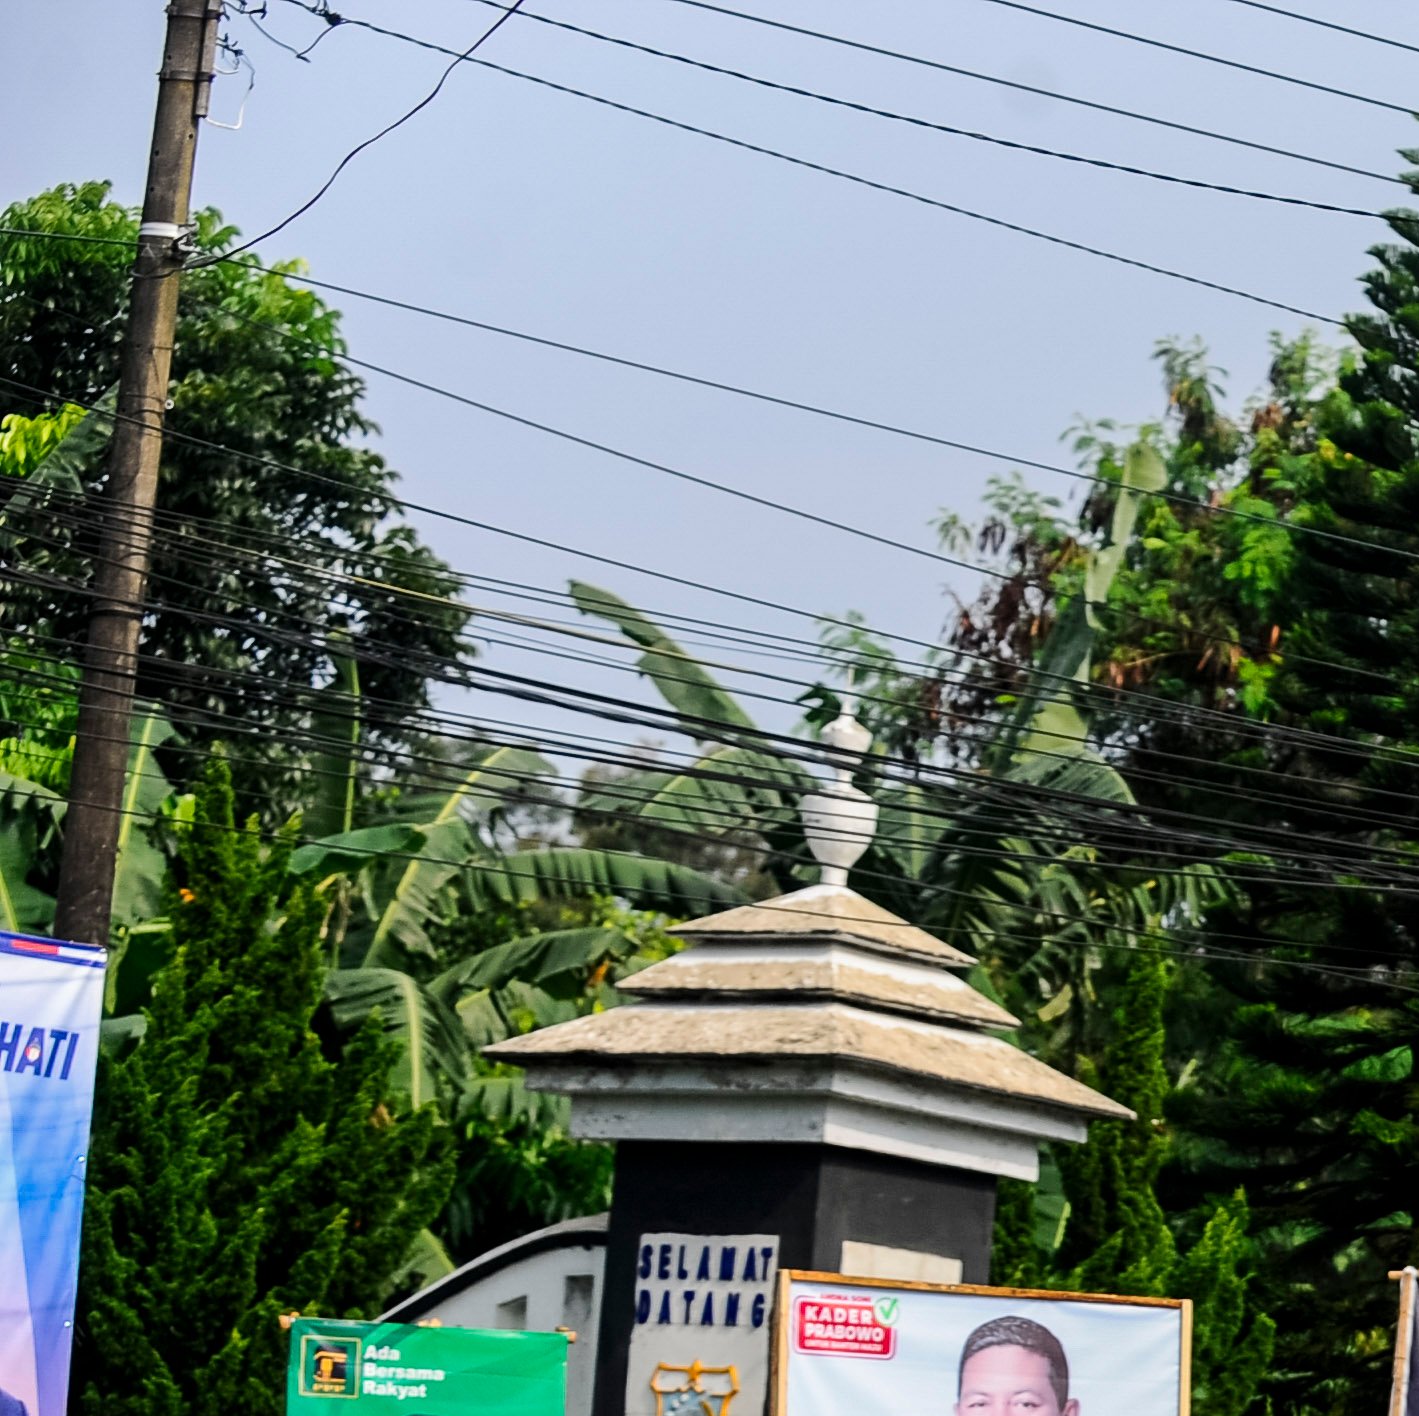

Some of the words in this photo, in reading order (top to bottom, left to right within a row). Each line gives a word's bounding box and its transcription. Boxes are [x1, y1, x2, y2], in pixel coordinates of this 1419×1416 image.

[0, 1021, 80, 1081] HATI
[638, 1243, 774, 1282] SELAMAT
[635, 1289, 766, 1329] DATANG
[804, 1305, 873, 1325] KADER
[804, 1322, 885, 1342] PRABOWO
[363, 1345, 401, 1361] Ada
[362, 1362, 446, 1382] Bersama
[362, 1380, 428, 1401] Rakyat
